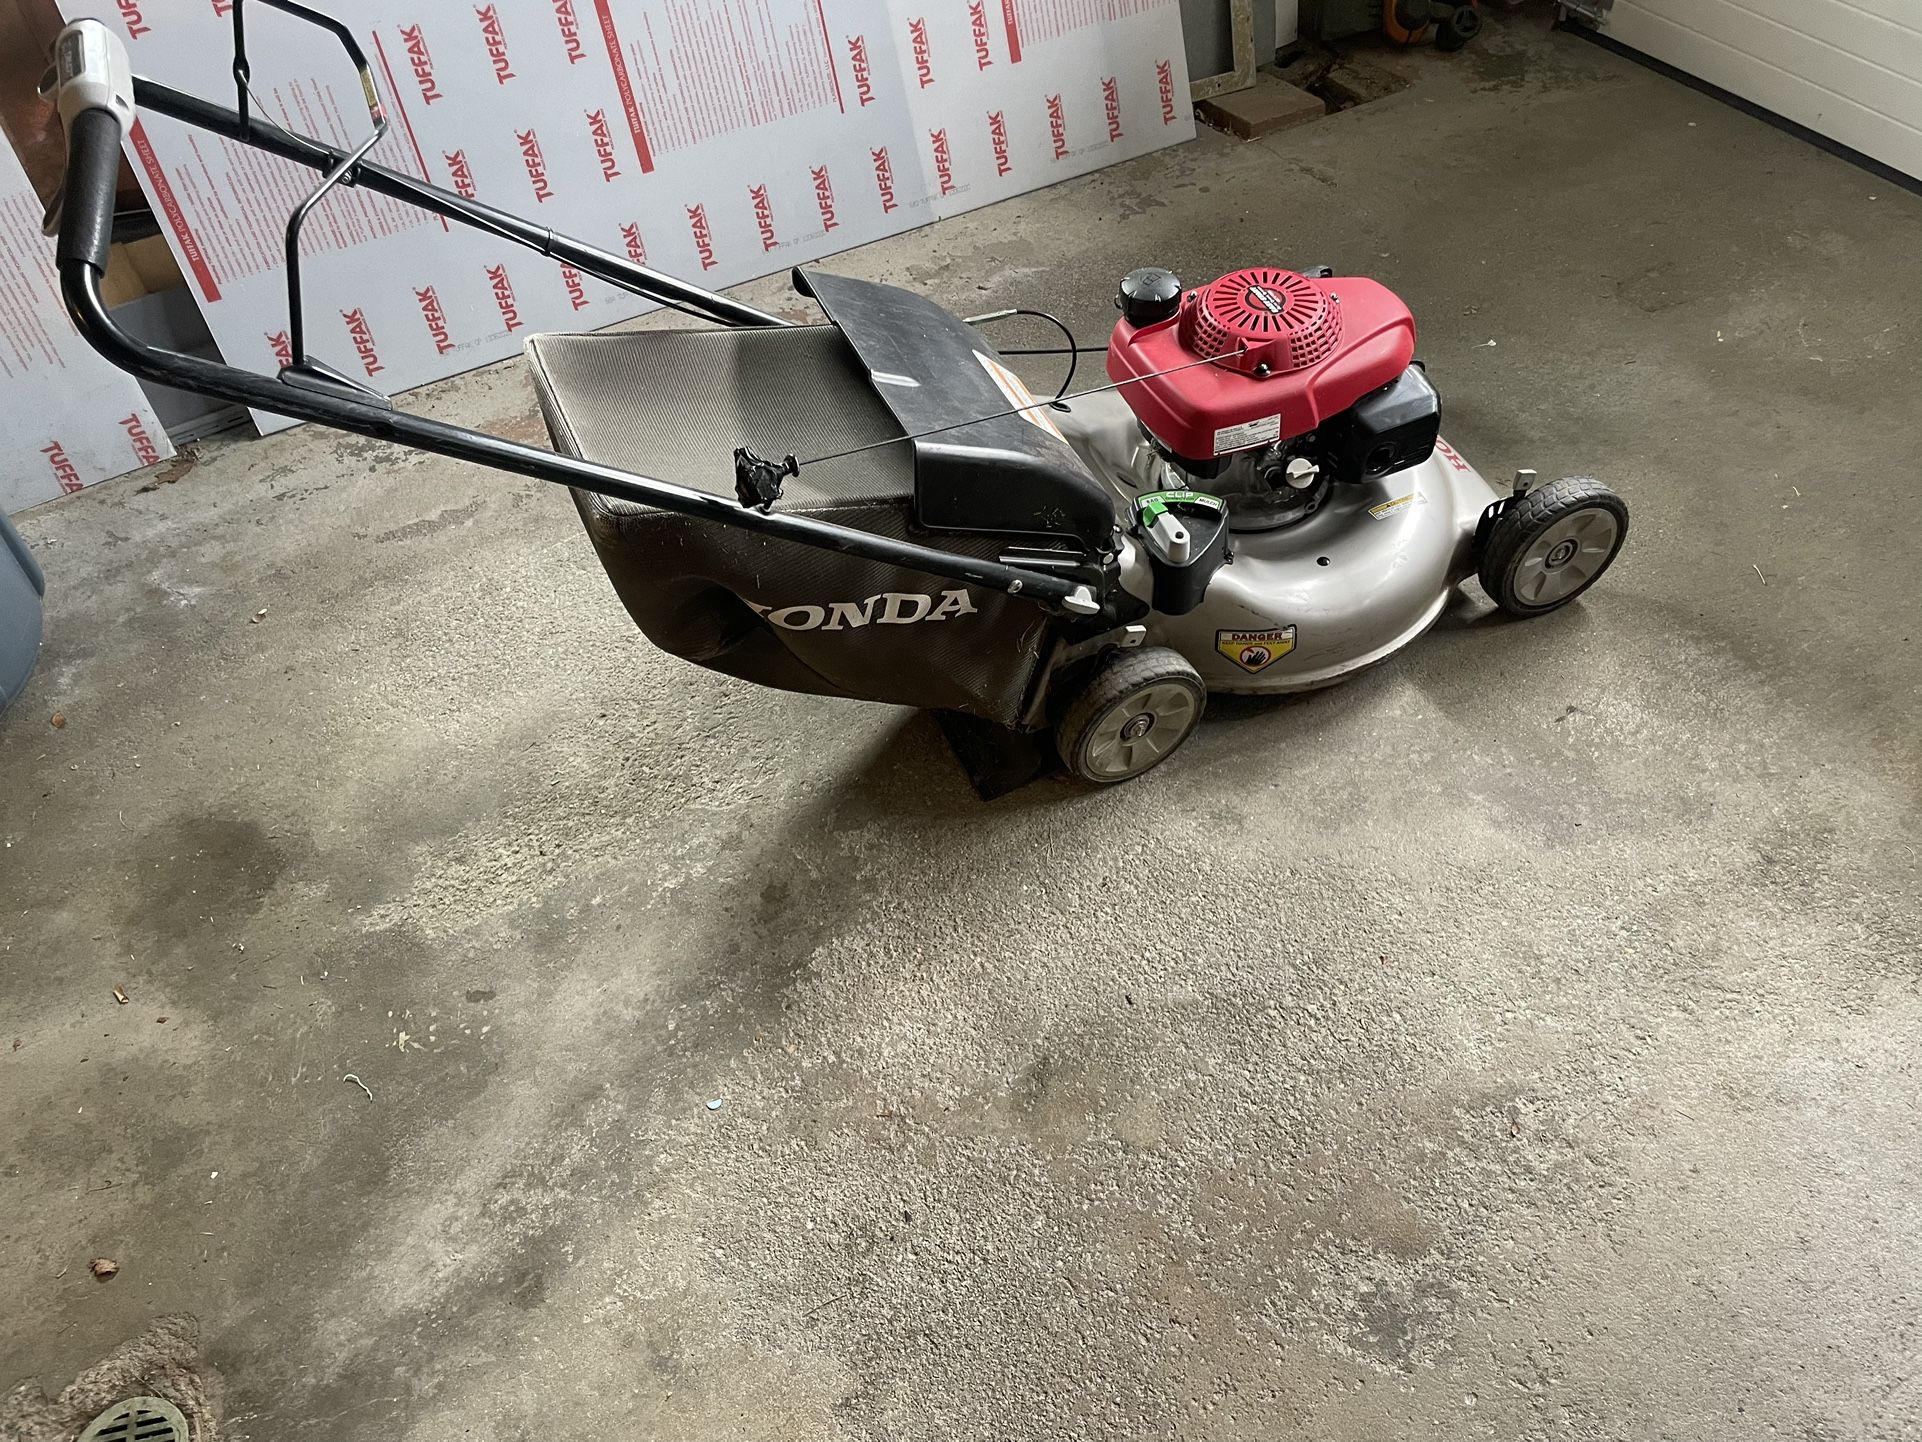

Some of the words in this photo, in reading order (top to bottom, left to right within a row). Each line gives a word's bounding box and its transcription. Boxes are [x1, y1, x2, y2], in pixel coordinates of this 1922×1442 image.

[116, 0, 151, 40] TUF
[477, 4, 516, 85] TUFFAK
[553, 0, 587, 64] TUFFA
[969, 1, 993, 71] TUFFAK
[402, 24, 443, 105] TUFFAK
[848, 36, 875, 107] TUFFAK
[909, 18, 935, 89] TUFFAK
[1102, 78, 1123, 142] TUFFAK
[1157, 61, 1177, 125] TUFFAK
[136, 138, 155, 165] SHEET
[586, 110, 621, 182] TUFFAK
[989, 112, 1012, 177] TUFFAK
[1046, 95, 1070, 160] TUFFAK
[445, 150, 475, 198] FFAK
[516, 130, 554, 203] TUFFAK
[872, 148, 898, 214] TUFFAK
[931, 129, 956, 195] TUFFAK
[147, 165, 187, 232] POLYCARBONATE
[750, 185, 779, 252] TUFFAK
[811, 166, 839, 232] TUFFAK
[180, 232, 201, 262] TUFFAK
[620, 223, 645, 265] FAK
[687, 204, 718, 271] TUFFAK
[486, 265, 524, 332] TUFFAK
[560, 263, 590, 311] TUFF
[267, 331, 292, 368] FAK
[343, 309, 384, 377] TUFFAK
[416, 287, 455, 354] TUFFAK
[40, 441, 84, 493] TUFFA
[118, 413, 161, 465] TUFFA
[743, 589, 977, 630] ONDA
[1231, 632, 1283, 641] DANGER
